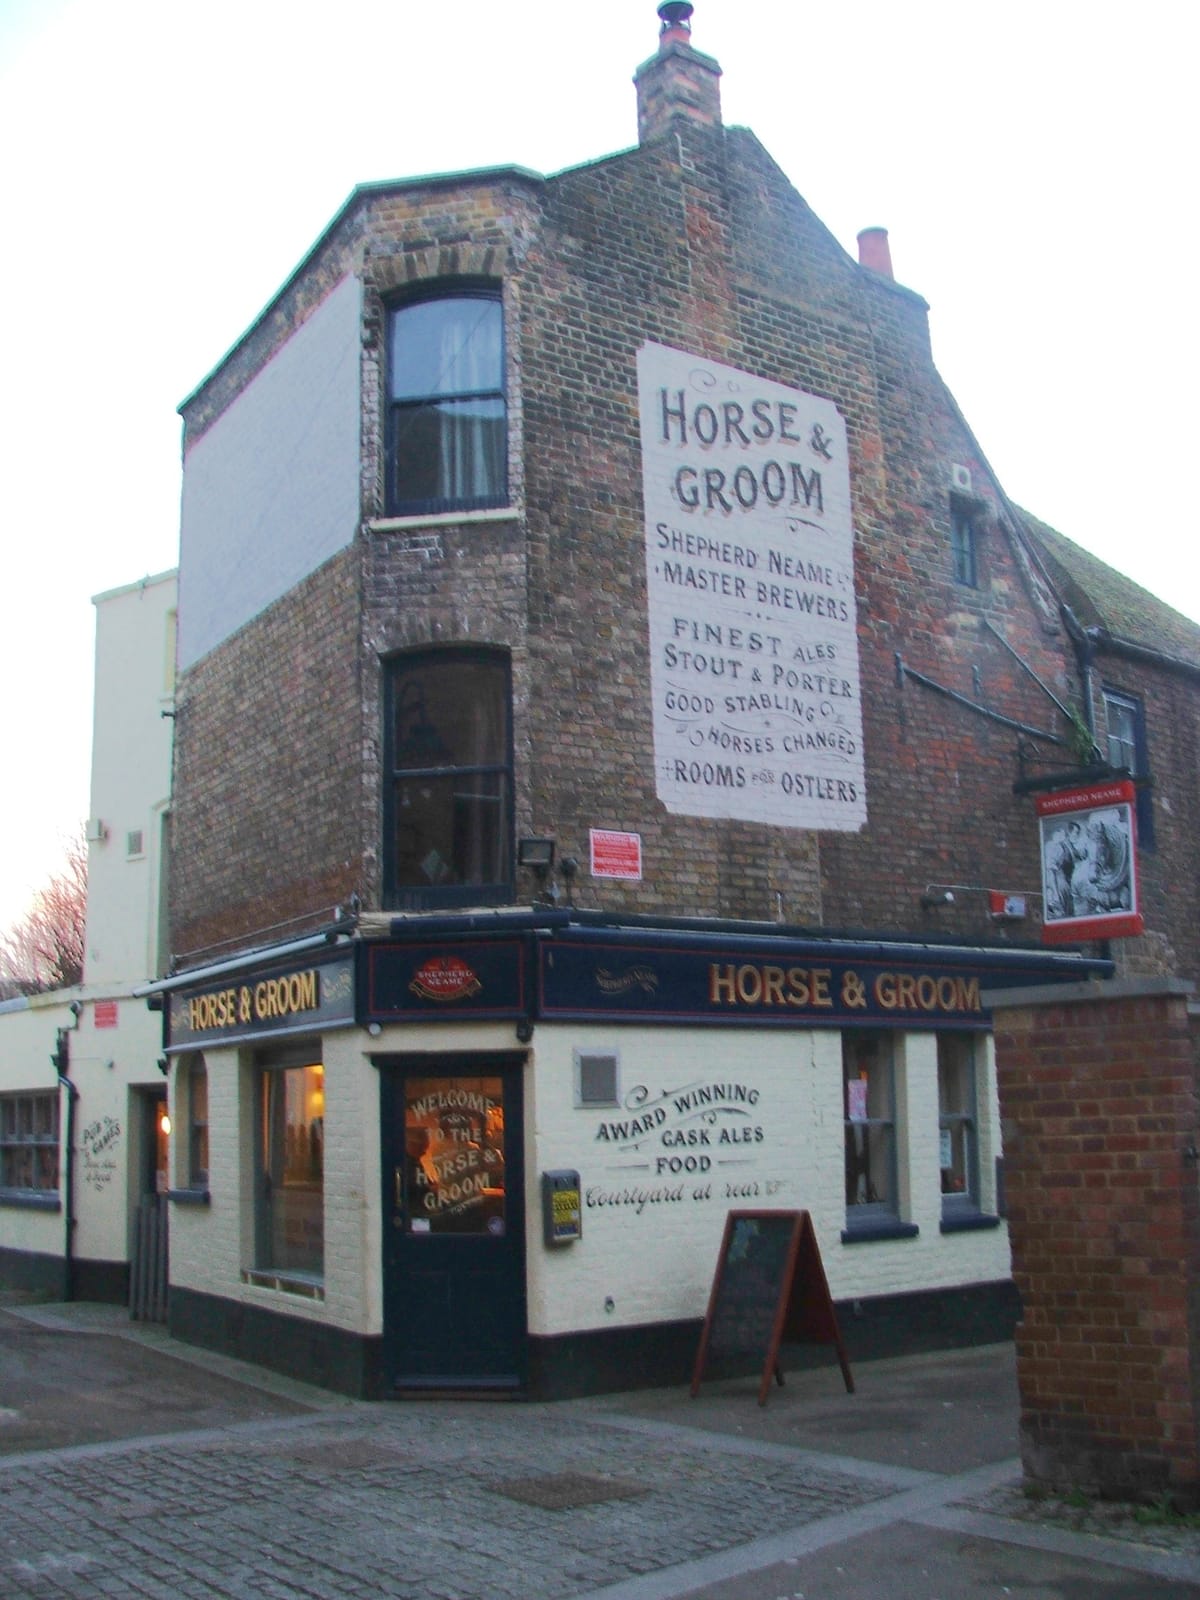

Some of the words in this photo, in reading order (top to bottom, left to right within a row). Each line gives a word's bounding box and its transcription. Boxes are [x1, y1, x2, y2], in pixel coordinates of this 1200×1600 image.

[660, 387, 802, 447] HORSE
[811, 423, 833, 461] &
[674, 459, 825, 515] GROOM
[656, 523, 758, 569] SHEPHERD
[768, 549, 833, 587] NEAME
[663, 560, 747, 600] MASTER
[756, 580, 849, 622] BREWERS
[672, 617, 782, 657] FINEST
[792, 643, 836, 662] ALES
[664, 642, 743, 680] STOUT
[752, 667, 762, 683] &
[772, 663, 853, 698] PORTER
[665, 691, 715, 715] GOOD
[724, 693, 815, 723] STABLING
[708, 725, 775, 754] HORSES
[782, 732, 856, 755] CHANGED
[674, 758, 746, 789] ROOMS
[781, 771, 858, 803] OSTLERS
[1042, 794, 1089, 809] SHEPHERD
[1090, 788, 1122, 801] NEAME
[417, 969, 473, 979] SHEPHERD
[428, 977, 464, 986] NEAME
[709, 963, 834, 1008] HORSE
[842, 970, 868, 1009] &
[874, 971, 982, 1013] GROOM
[189, 987, 237, 1031] HORSE
[239, 985, 251, 1023] &
[255, 968, 318, 1020] GROOM
[411, 1089, 496, 1121] WELCOME
[594, 1107, 667, 1142] AWARD
[674, 1083, 760, 1114] WINNING
[449, 1127, 483, 1144] THE
[661, 1129, 711, 1148] CASK
[718, 1126, 765, 1144] ALES
[415, 1149, 479, 1186] HORSE
[655, 1154, 712, 1175] FOOD
[423, 1171, 491, 1211] GROOM
[585, 1183, 685, 1215] Courtyard
[692, 1180, 712, 1200] at
[725, 1180, 760, 1198] rear
